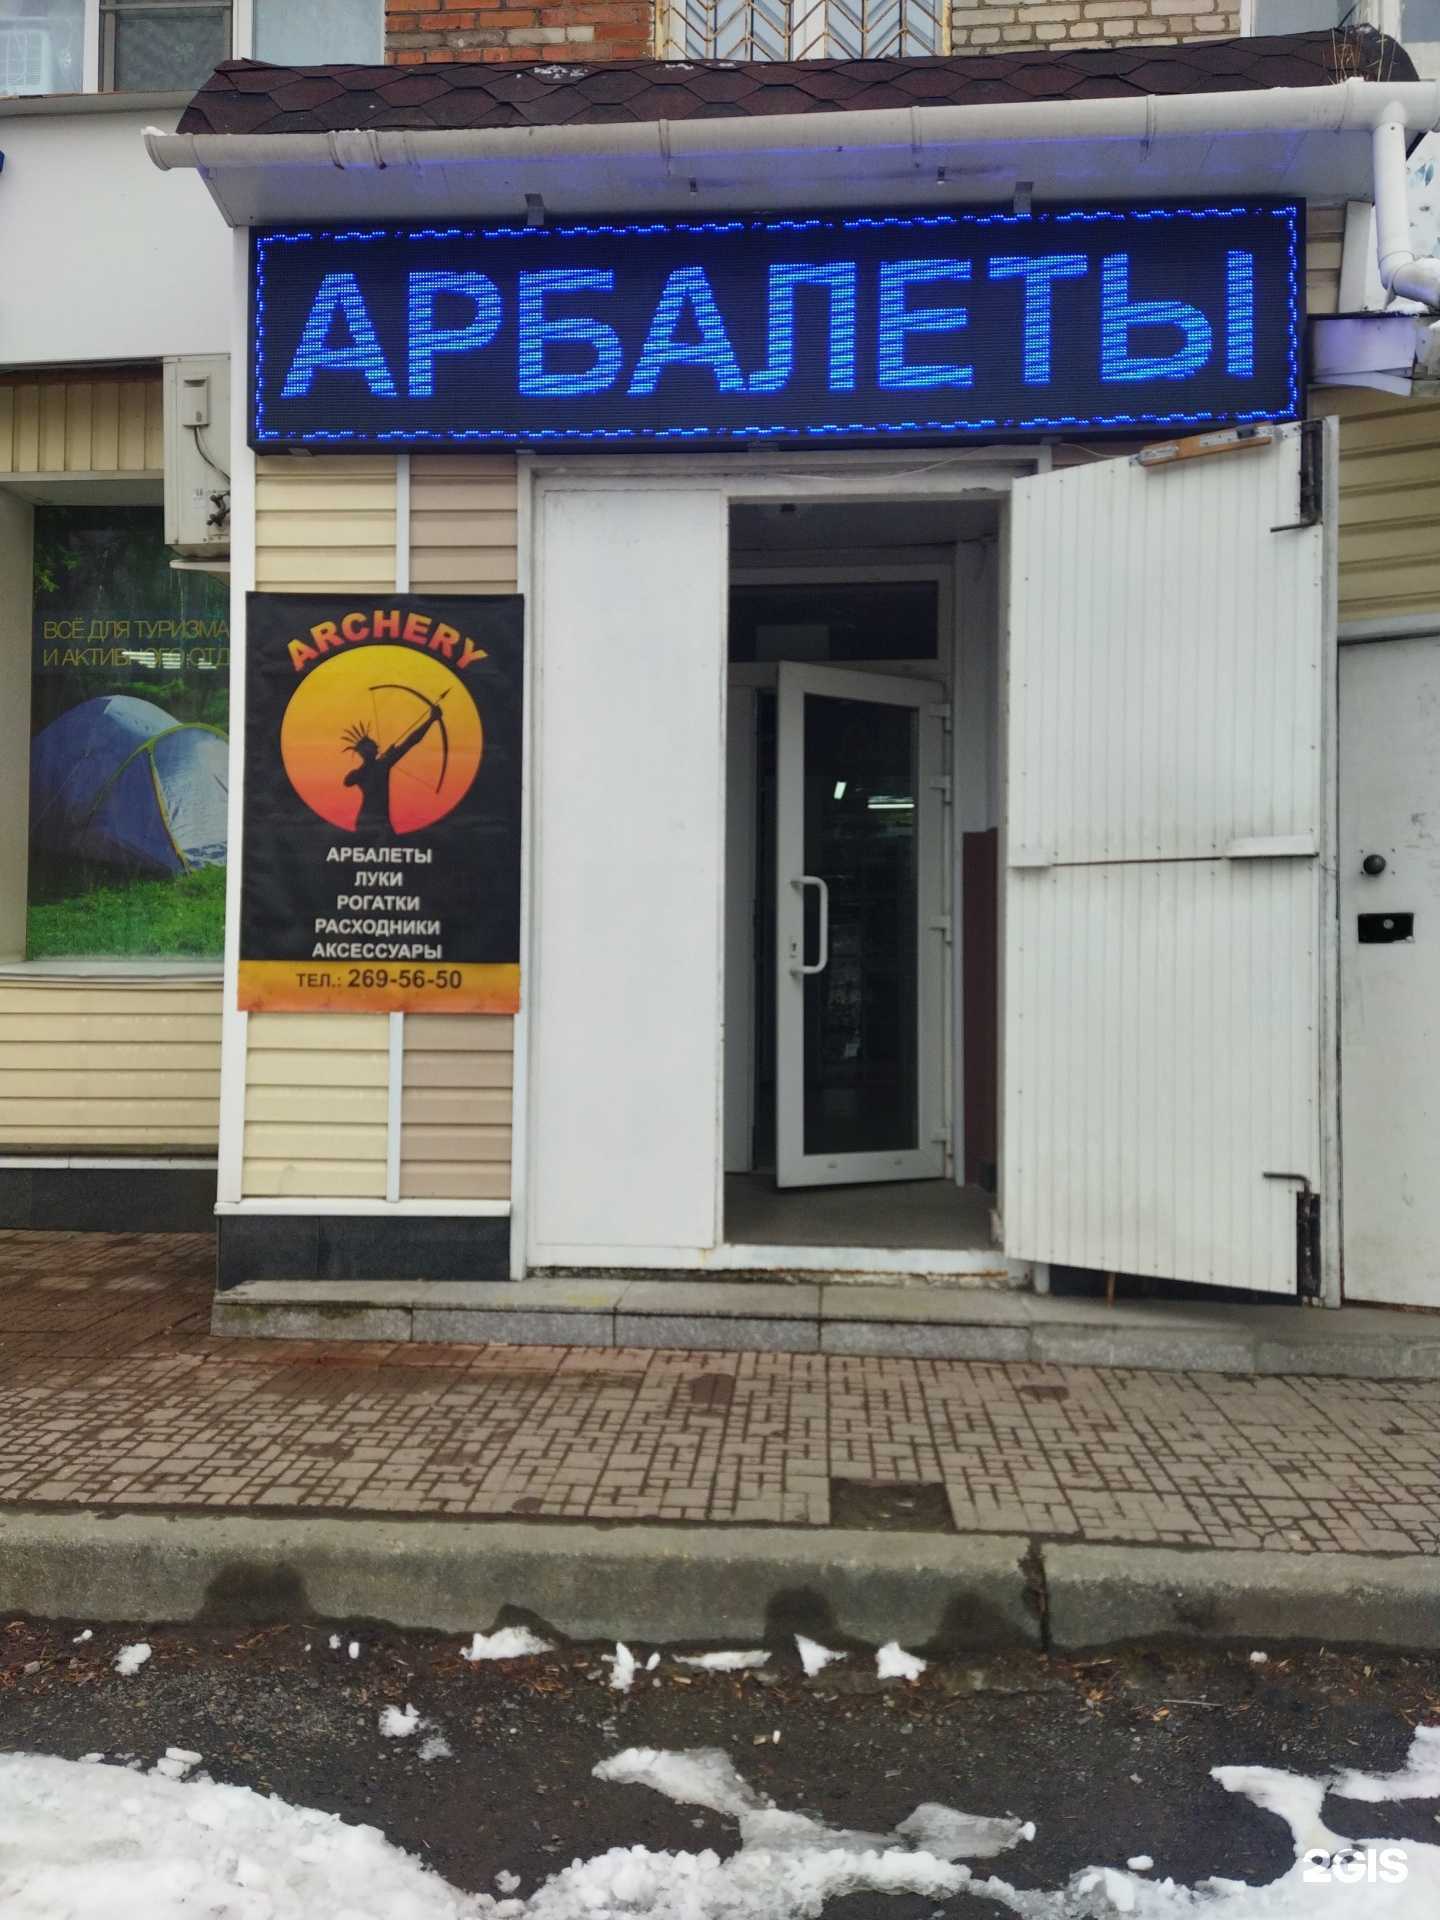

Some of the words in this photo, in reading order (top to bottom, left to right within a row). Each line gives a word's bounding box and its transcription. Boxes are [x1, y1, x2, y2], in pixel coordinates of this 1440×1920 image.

[279, 249, 1254, 398] АРБАЛЕТЫ
[43, 617, 84, 640] ВСЁ
[87, 619, 130, 642] ДЛЯ
[133, 619, 230, 640] ТУРИЗМА
[287, 609, 489, 672] ARCHERY
[43, 648, 58, 666] И
[326, 847, 432, 864] АРБАЛЕТЫ
[354, 871, 403, 887] ЛУКИ
[336, 895, 420, 911] РОГАТКИ
[315, 918, 441, 937] РАСХОДНИКИ
[312, 943, 442, 959] АКСЕССУАРЫ
[296, 972, 342, 988] ТЕЛ.:
[347, 968, 463, 989] 269-56-50
